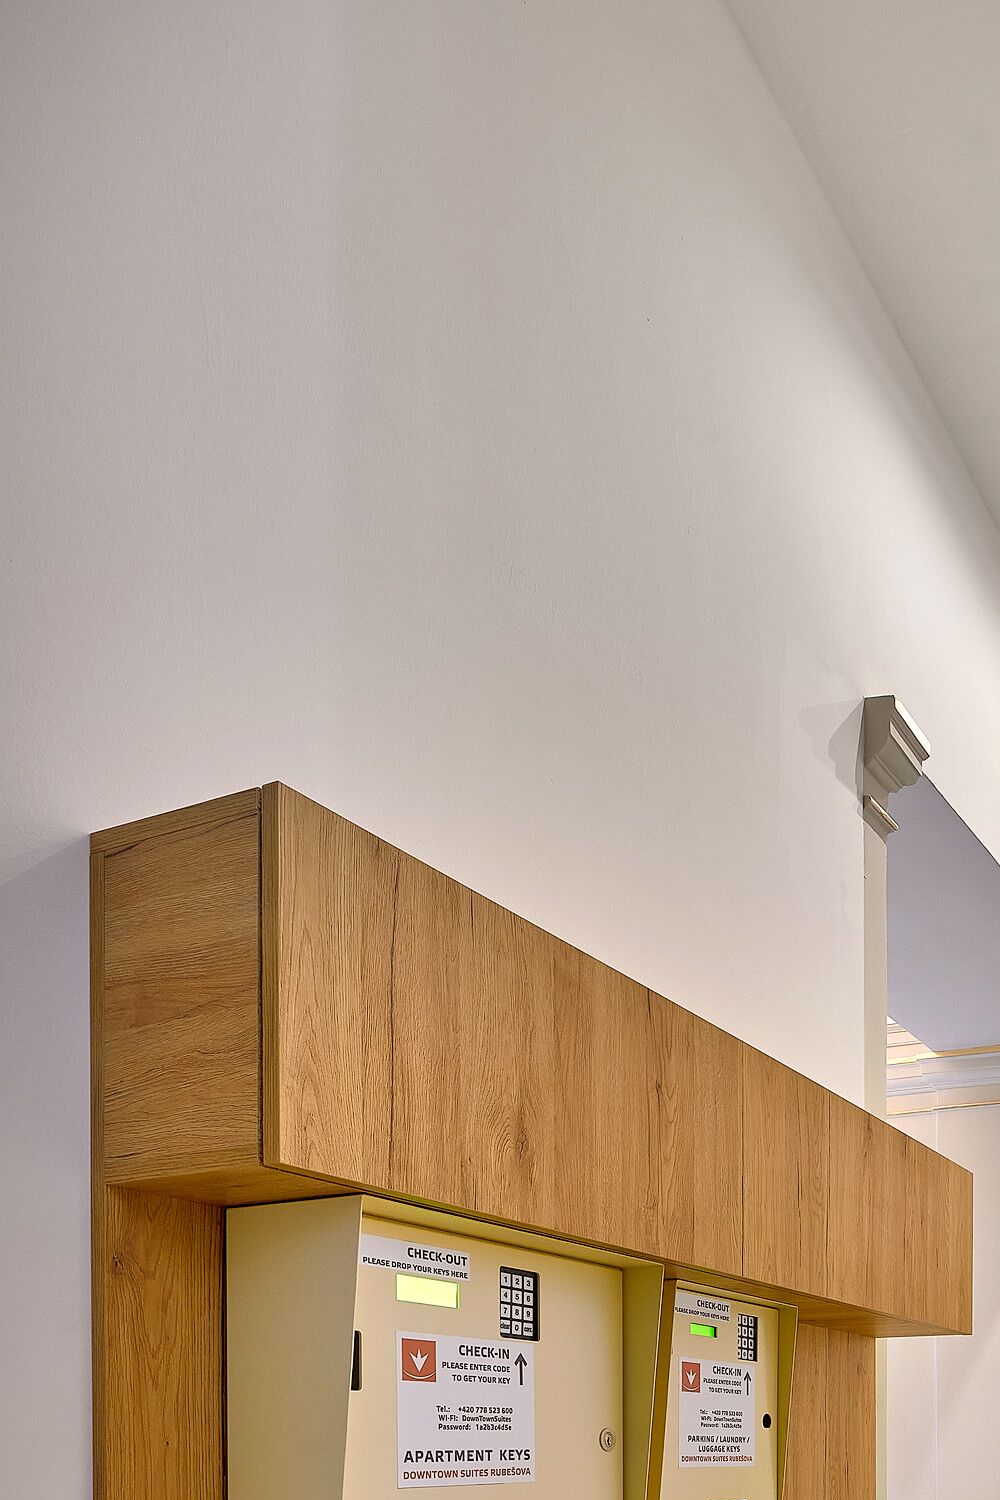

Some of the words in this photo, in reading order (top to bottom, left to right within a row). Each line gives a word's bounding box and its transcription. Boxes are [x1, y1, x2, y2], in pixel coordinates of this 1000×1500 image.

[407, 1247, 468, 1267] CHECK-OUT
[362, 1256, 391, 1267] PLEASE
[391, 1261, 412, 1270] DROP
[412, 1264, 432, 1274] YOUR
[433, 1267, 450, 1277] KEYS
[450, 1270, 468, 1279] HERE
[697, 1299, 730, 1312] CHECK-OUT
[458, 1344, 510, 1360] CHECK-IN
[441, 1361, 468, 1370] PLEASE
[469, 1363, 492, 1372] ENTER
[492, 1365, 511, 1373] CODE
[712, 1365, 742, 1377] CHECK-IN
[452, 1374, 463, 1382] TO
[463, 1374, 477, 1383] GET
[477, 1375, 497, 1384] YOUR
[497, 1376, 511, 1385] KEY
[703, 1377, 718, 1385] PLEASE
[436, 1405, 451, 1413] Tel.:
[475, 1406, 488, 1414] 778
[461, 1415, 512, 1423] DownTownSuites
[438, 1423, 472, 1431] Password:
[687, 1435, 715, 1443] PARKING
[719, 1435, 747, 1443] LAUNDRY
[698, 1445, 725, 1453] LUGGAGE
[726, 1445, 741, 1453] KEYS
[403, 1449, 493, 1463] APARTMENT
[499, 1449, 531, 1461] KEYS
[403, 1469, 459, 1480] DOWNTOWN
[460, 1468, 489, 1478] SUITES
[490, 1466, 531, 1477] RUBEŠOVA
